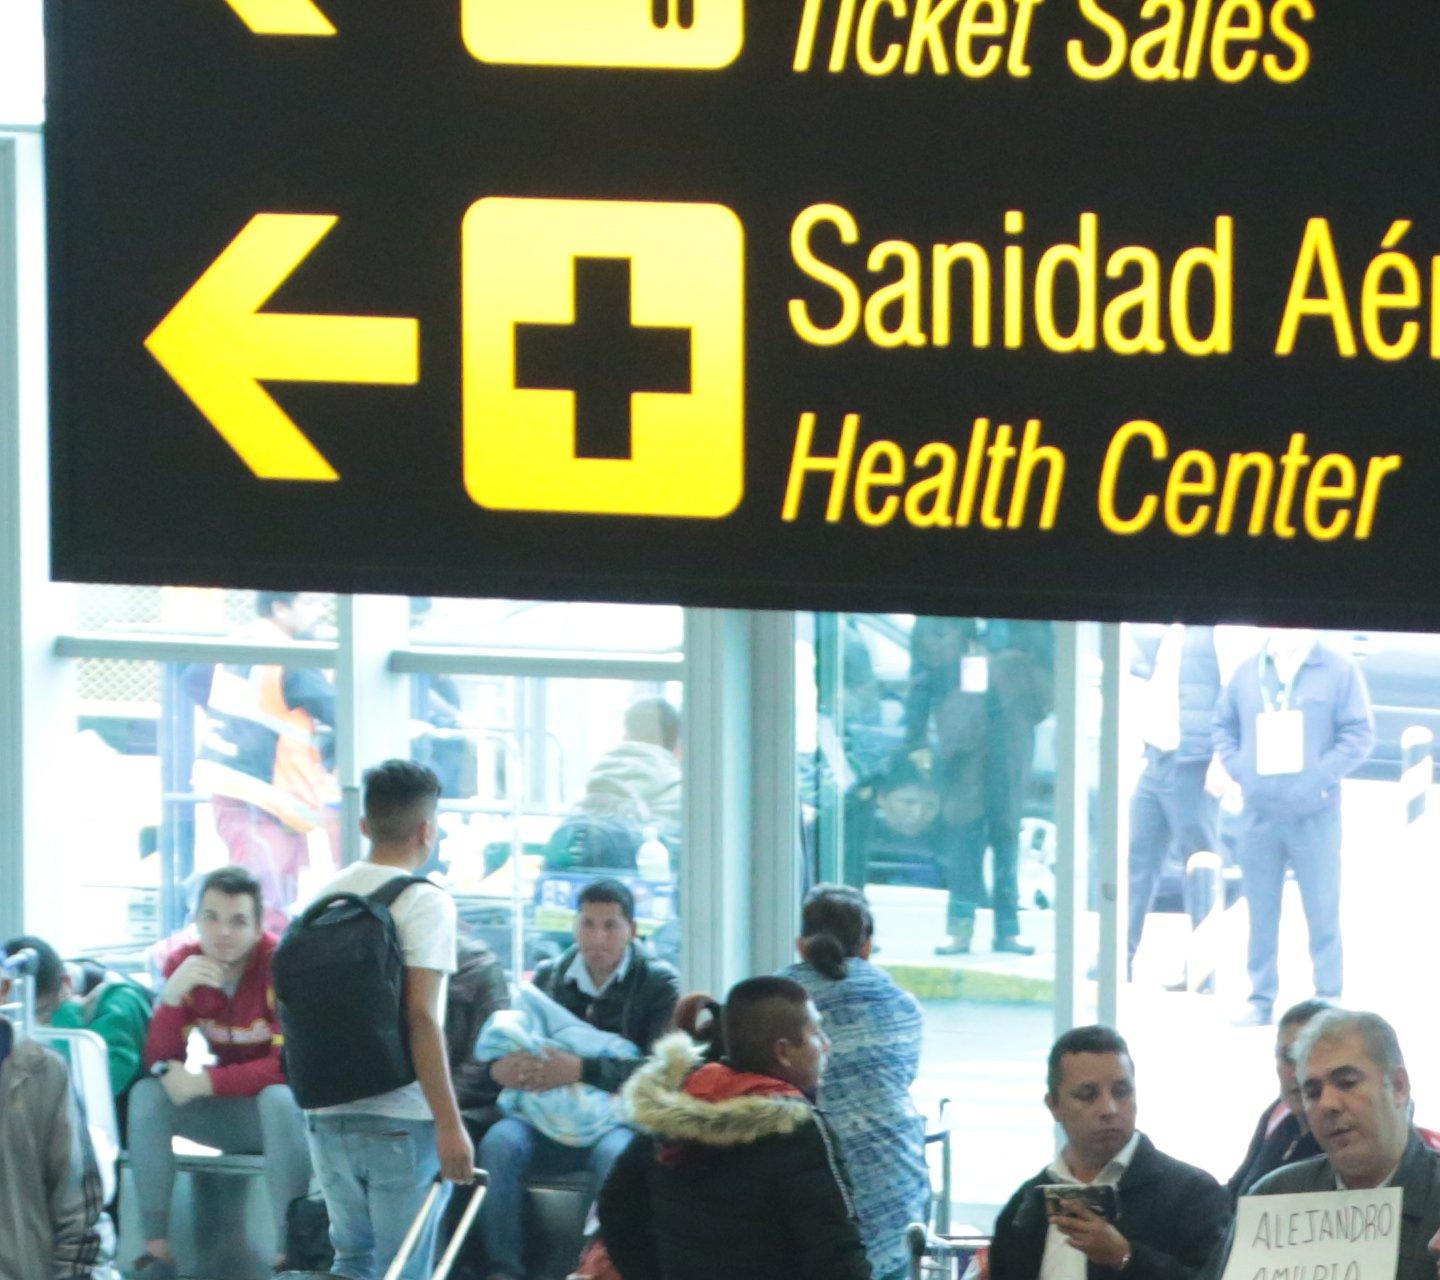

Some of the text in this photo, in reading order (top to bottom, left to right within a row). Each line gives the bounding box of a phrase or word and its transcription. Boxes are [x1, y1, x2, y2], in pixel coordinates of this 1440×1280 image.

[792, 0, 1315, 84] Ticket Sales
[787, 202, 1234, 356] Sanidad
[781, 411, 1402, 541] Health Center
[1251, 1202, 1395, 1251] ALEJANDRO
